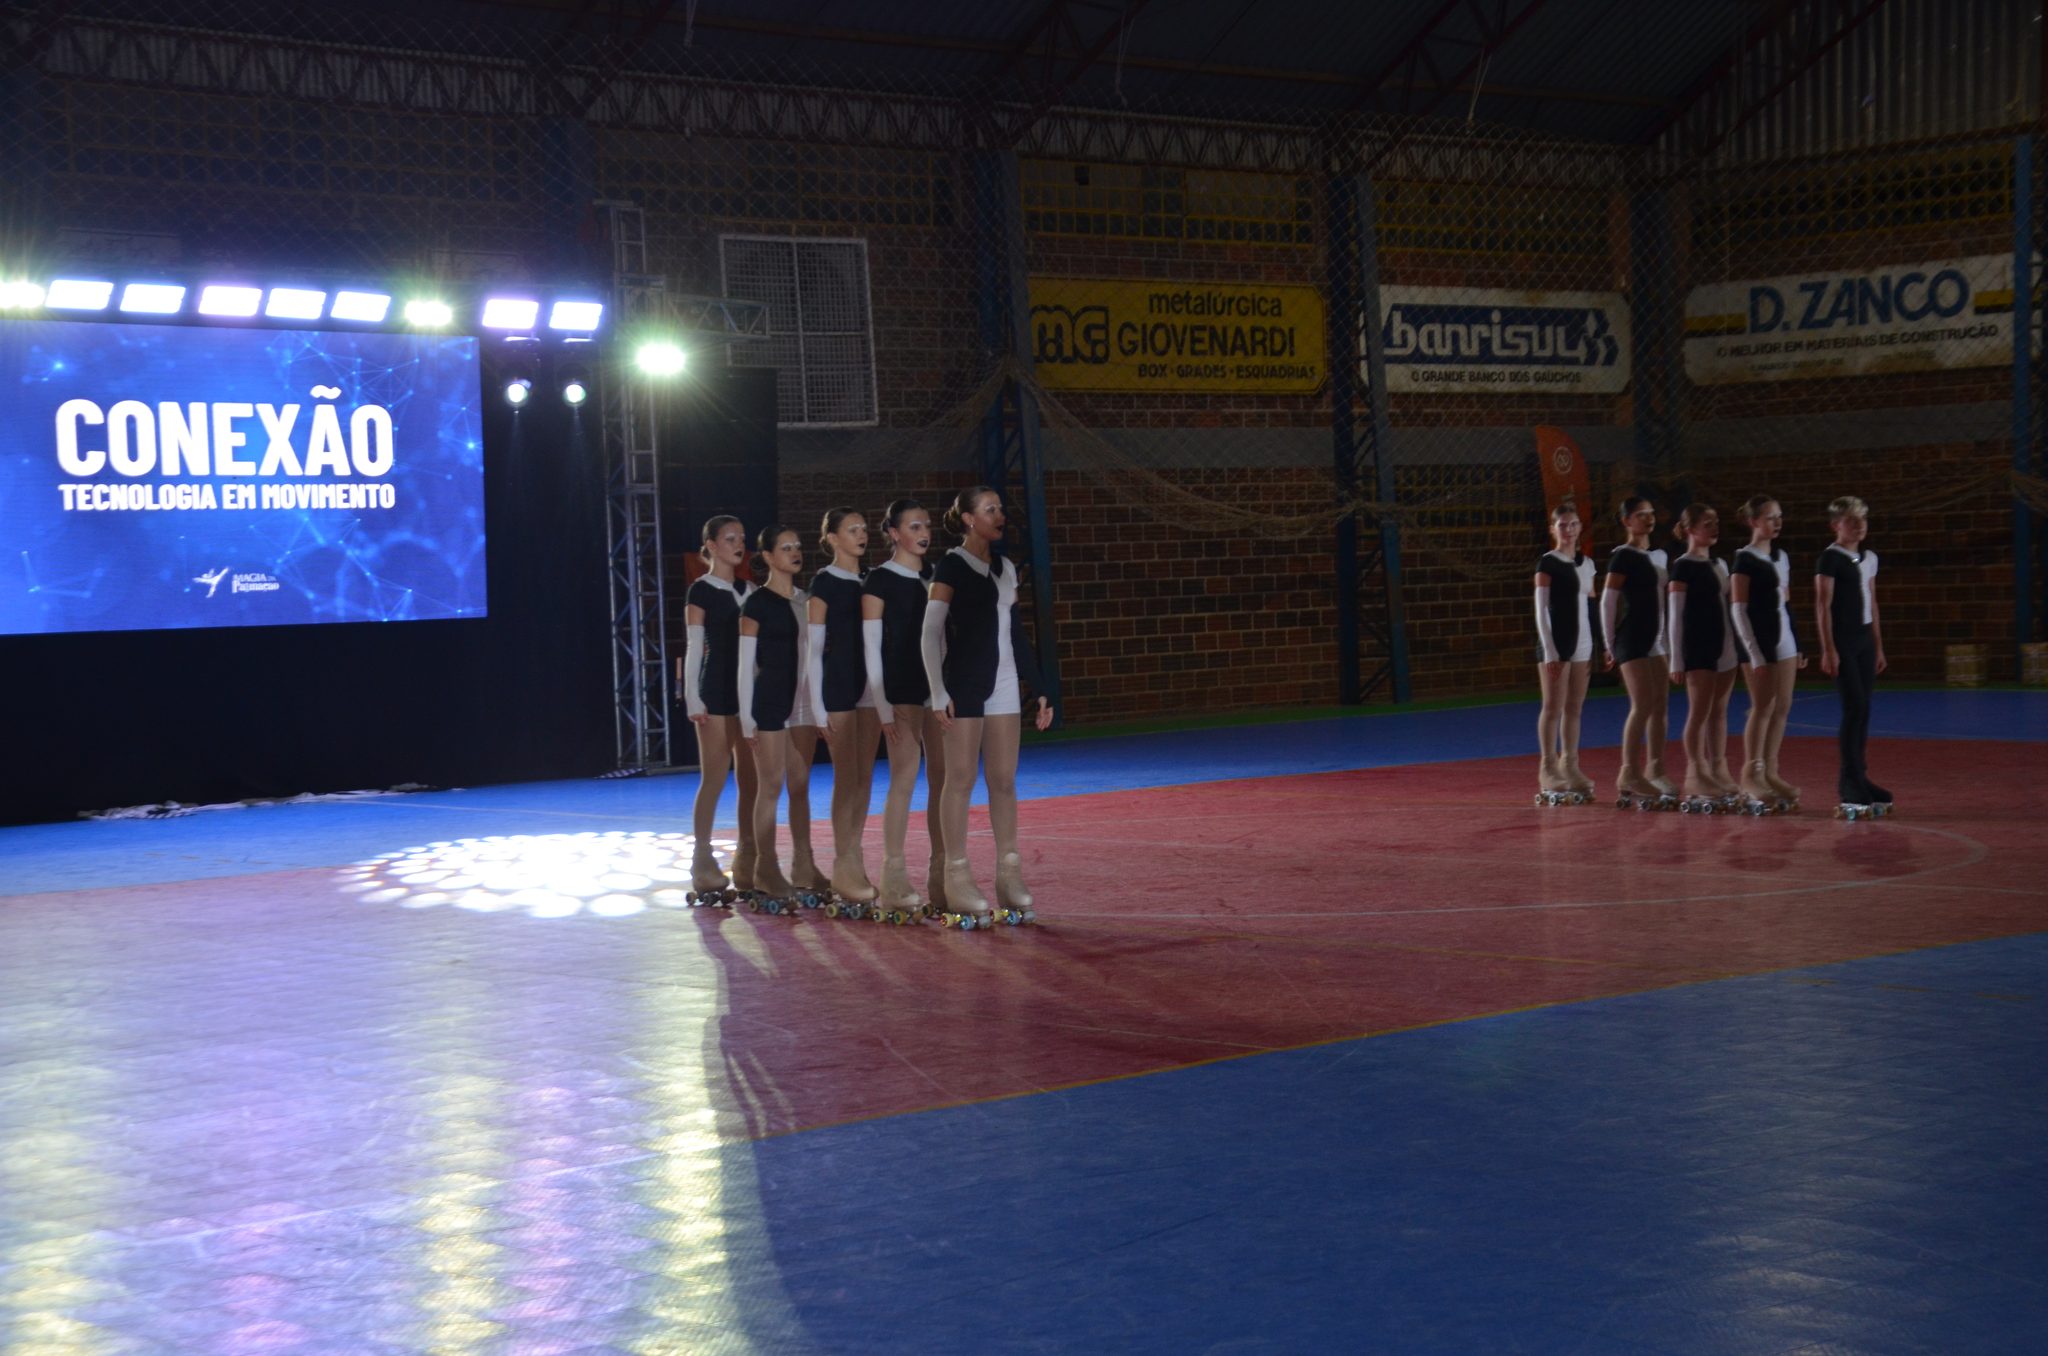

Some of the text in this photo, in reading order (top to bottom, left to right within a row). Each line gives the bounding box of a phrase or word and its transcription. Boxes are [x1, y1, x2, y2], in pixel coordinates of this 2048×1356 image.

[1116, 321, 1297, 358] GIOVENARDI
[1383, 308, 1584, 358] banrisul
[1730, 343, 1782, 360] MELHOR
[1784, 340, 1804, 354] EM
[1806, 335, 1877, 352] MATERIAIS
[1879, 333, 1898, 346] DE
[1137, 363, 1316, 379] BOX GRADES ESQUADRIAS
[1411, 371, 1420, 382] O
[1422, 370, 1466, 383] GRANDE
[1468, 371, 1506, 383] BANCO
[1509, 371, 1531, 383] DOS
[55, 384, 394, 477] CONEXÃO
[58, 483, 396, 511] TECNOLOGIA EM MOVIMENTO
